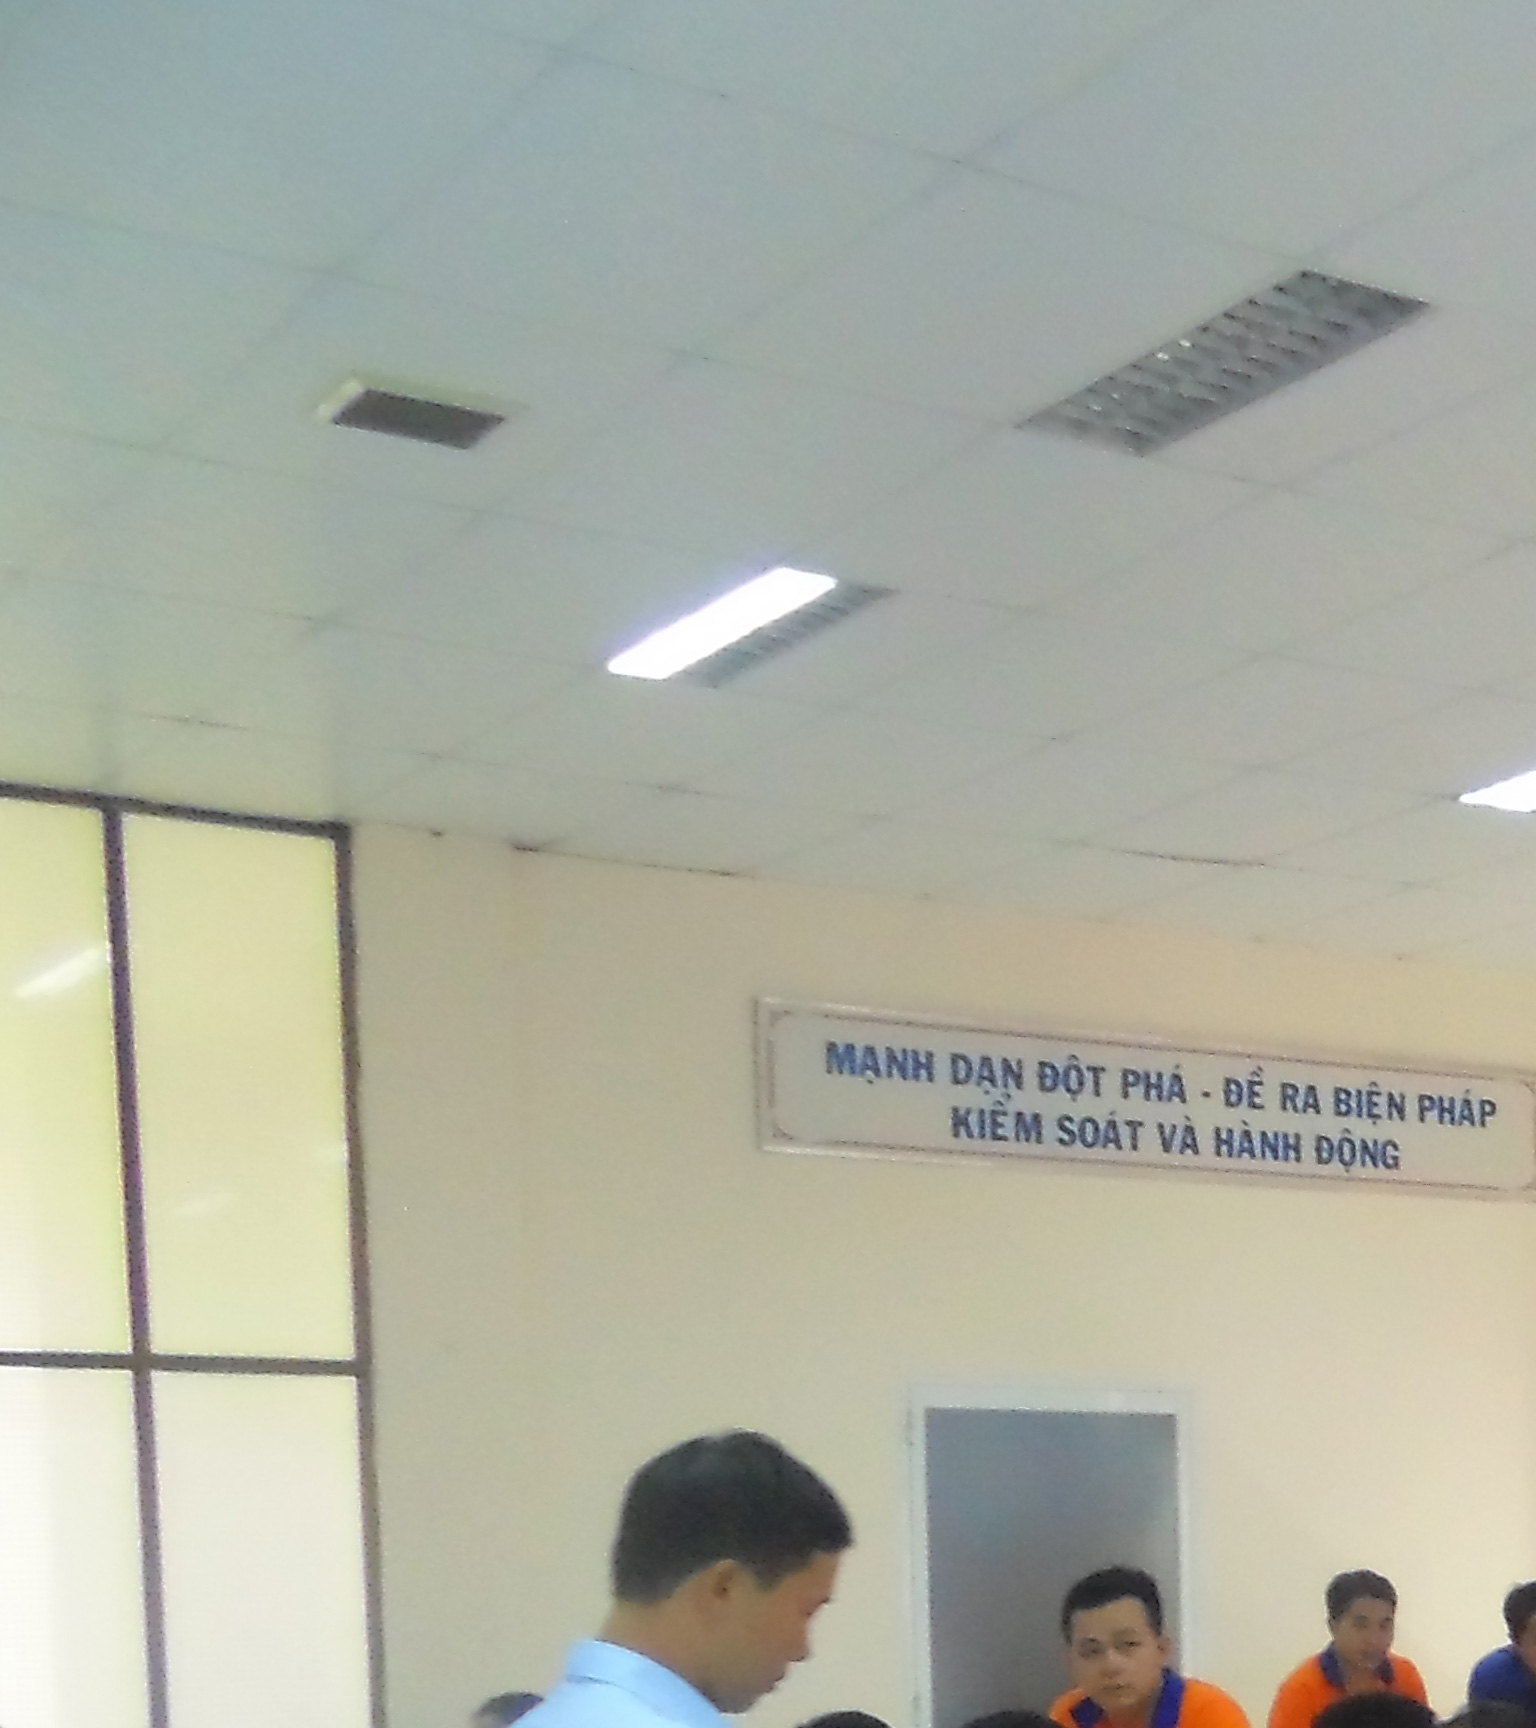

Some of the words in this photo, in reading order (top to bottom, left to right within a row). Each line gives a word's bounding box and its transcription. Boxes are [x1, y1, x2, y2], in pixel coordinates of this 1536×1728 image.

[825, 1040, 935, 1085] MẠNH
[950, 1053, 1024, 1095] DẠN
[1037, 1054, 1106, 1101] ĐỘT
[1121, 1064, 1187, 1104] PHÁ
[1222, 1065, 1265, 1110] ĐỀ
[1279, 1081, 1322, 1115] RA
[1332, 1081, 1406, 1126] BIỆN
[1417, 1089, 1497, 1128] PHÁP
[951, 1092, 1044, 1145] KIỂM
[1056, 1110, 1144, 1151] SOÁT
[1157, 1115, 1200, 1156] VÀ
[1214, 1119, 1302, 1163] HÀNH
[1314, 1127, 1400, 1173] ĐỘNG
